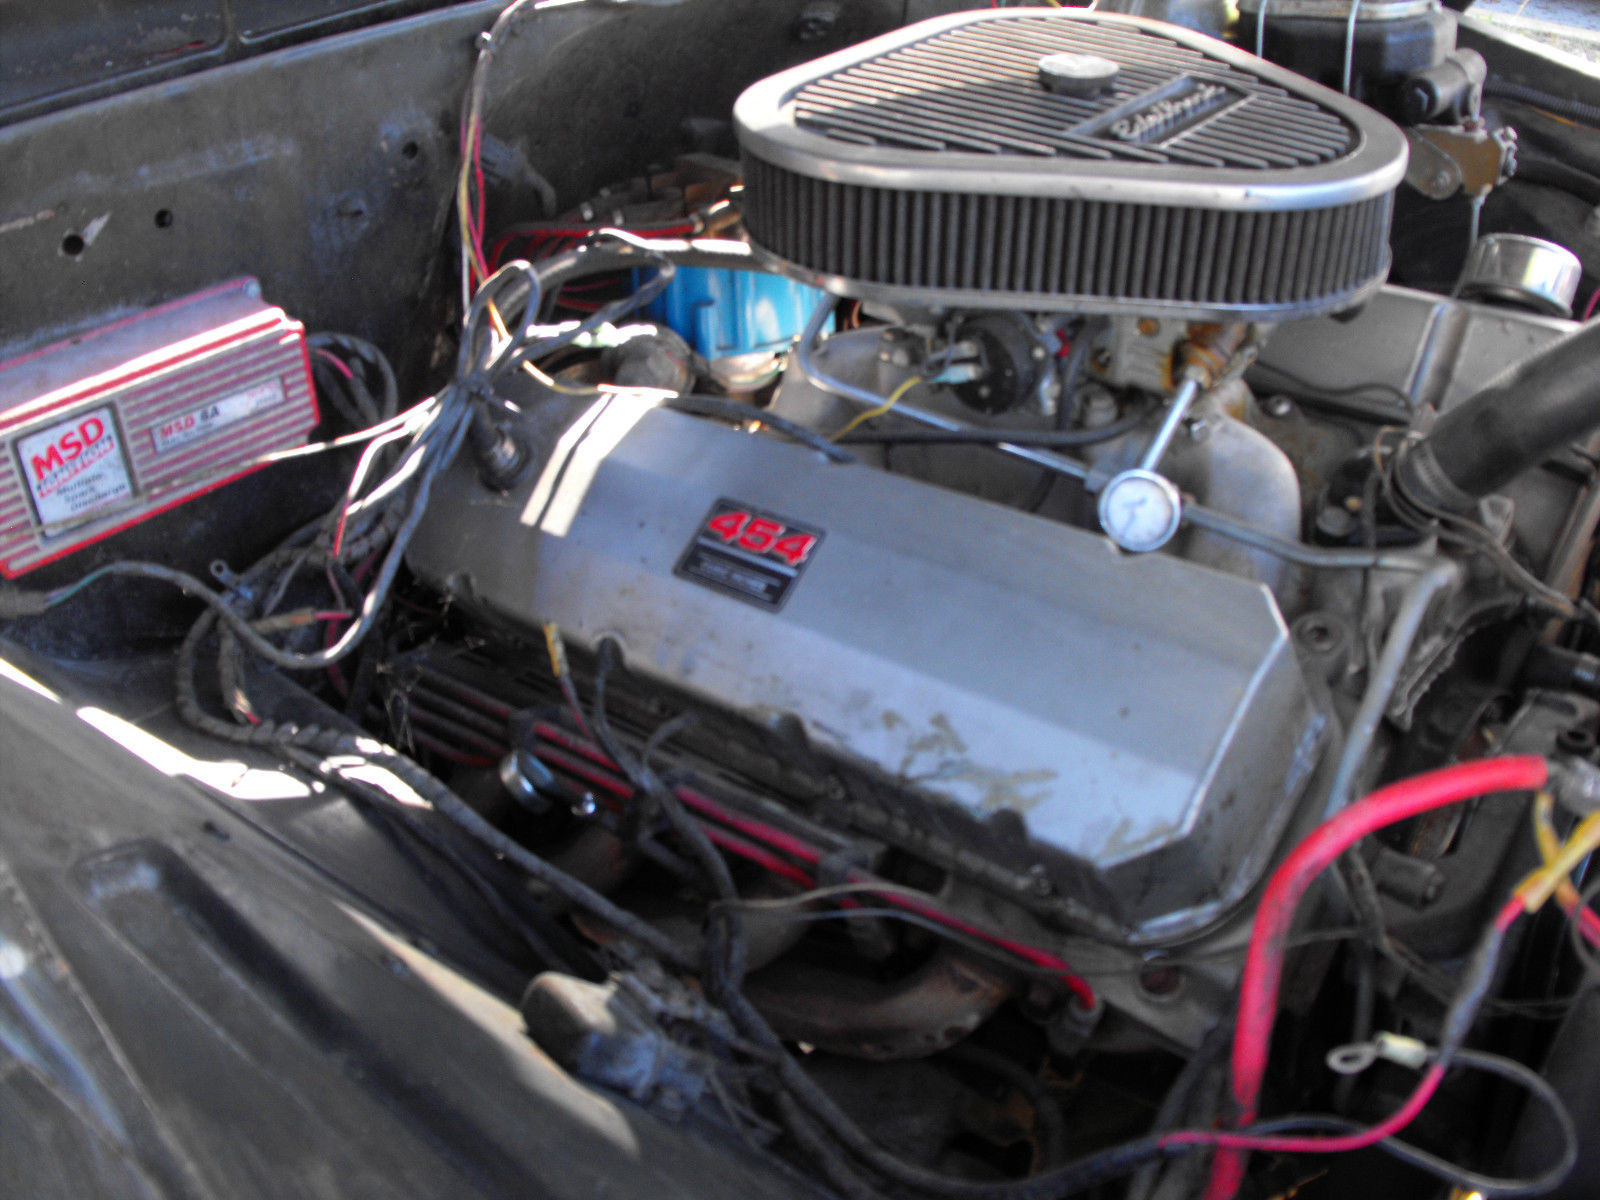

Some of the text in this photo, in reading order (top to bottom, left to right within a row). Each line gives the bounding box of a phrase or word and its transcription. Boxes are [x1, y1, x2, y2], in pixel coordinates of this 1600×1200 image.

[31, 417, 104, 480] MSD
[161, 415, 196, 438] MSD
[708, 511, 817, 567] 454
